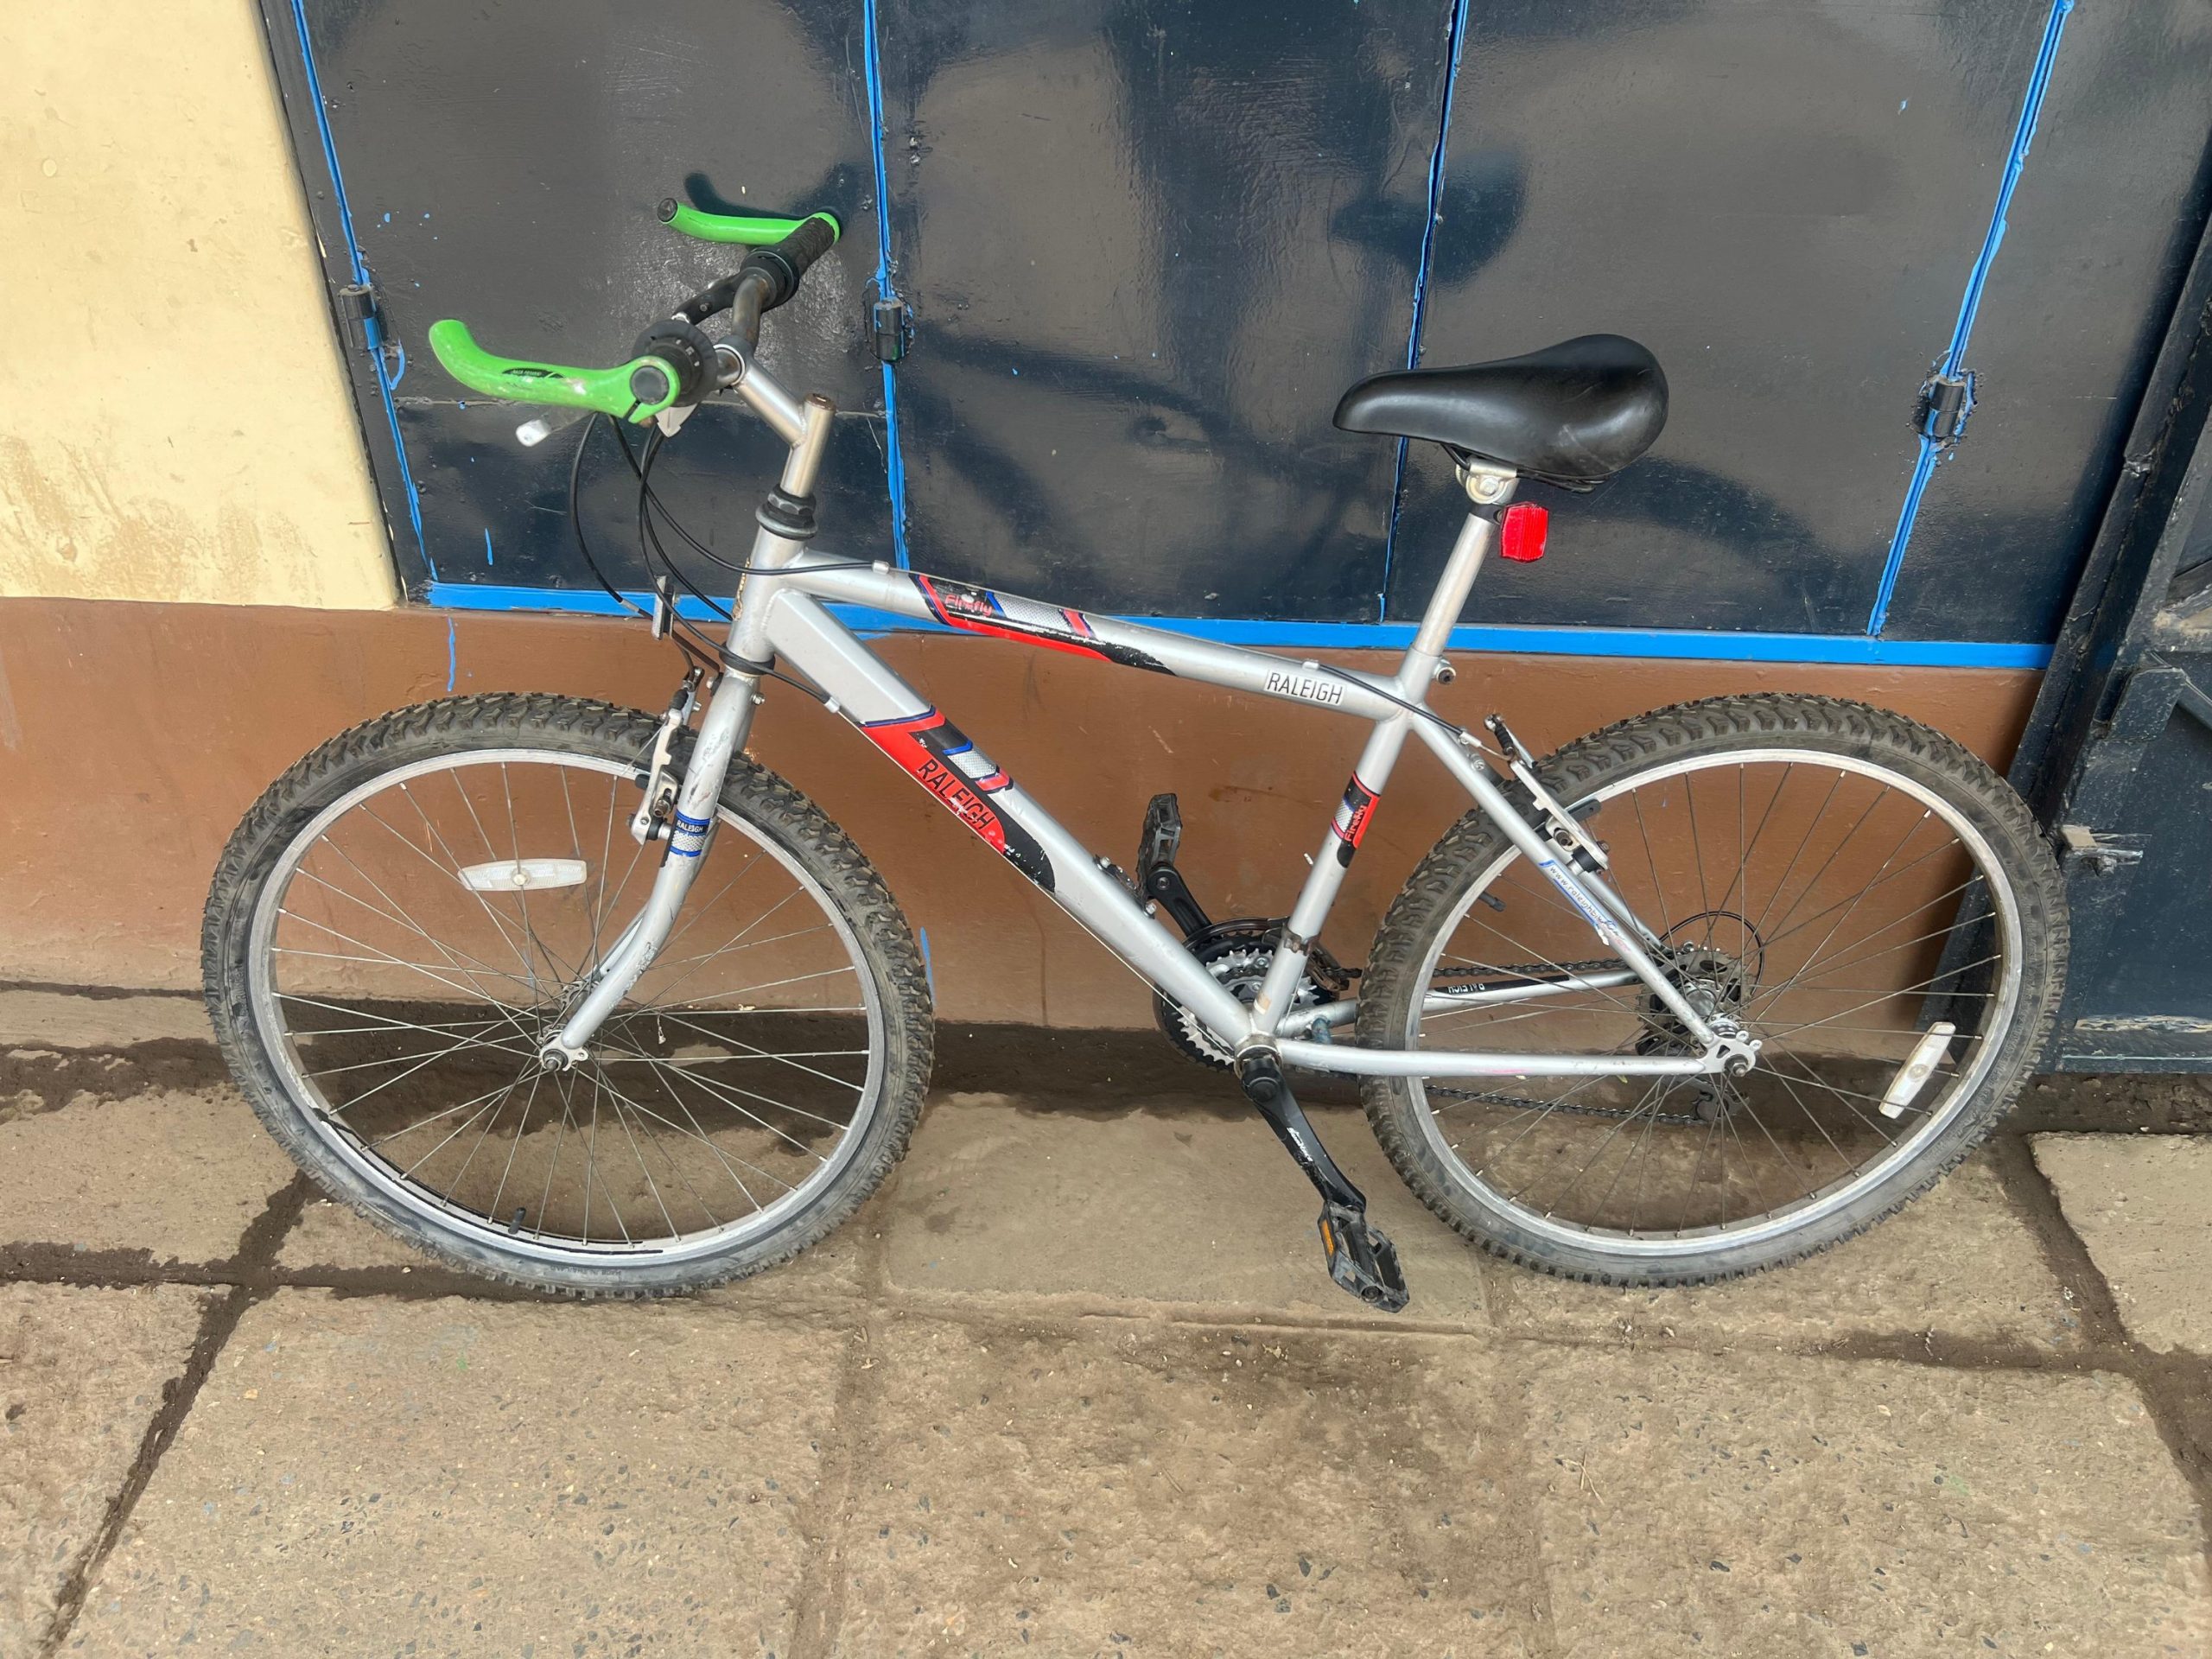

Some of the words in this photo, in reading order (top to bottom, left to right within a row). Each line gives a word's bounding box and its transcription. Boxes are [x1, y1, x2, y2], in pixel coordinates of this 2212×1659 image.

[1267, 672, 1343, 704] RALEIGH
[918, 759, 995, 830] RALEIGH
[677, 820, 703, 832] RALEIGH
